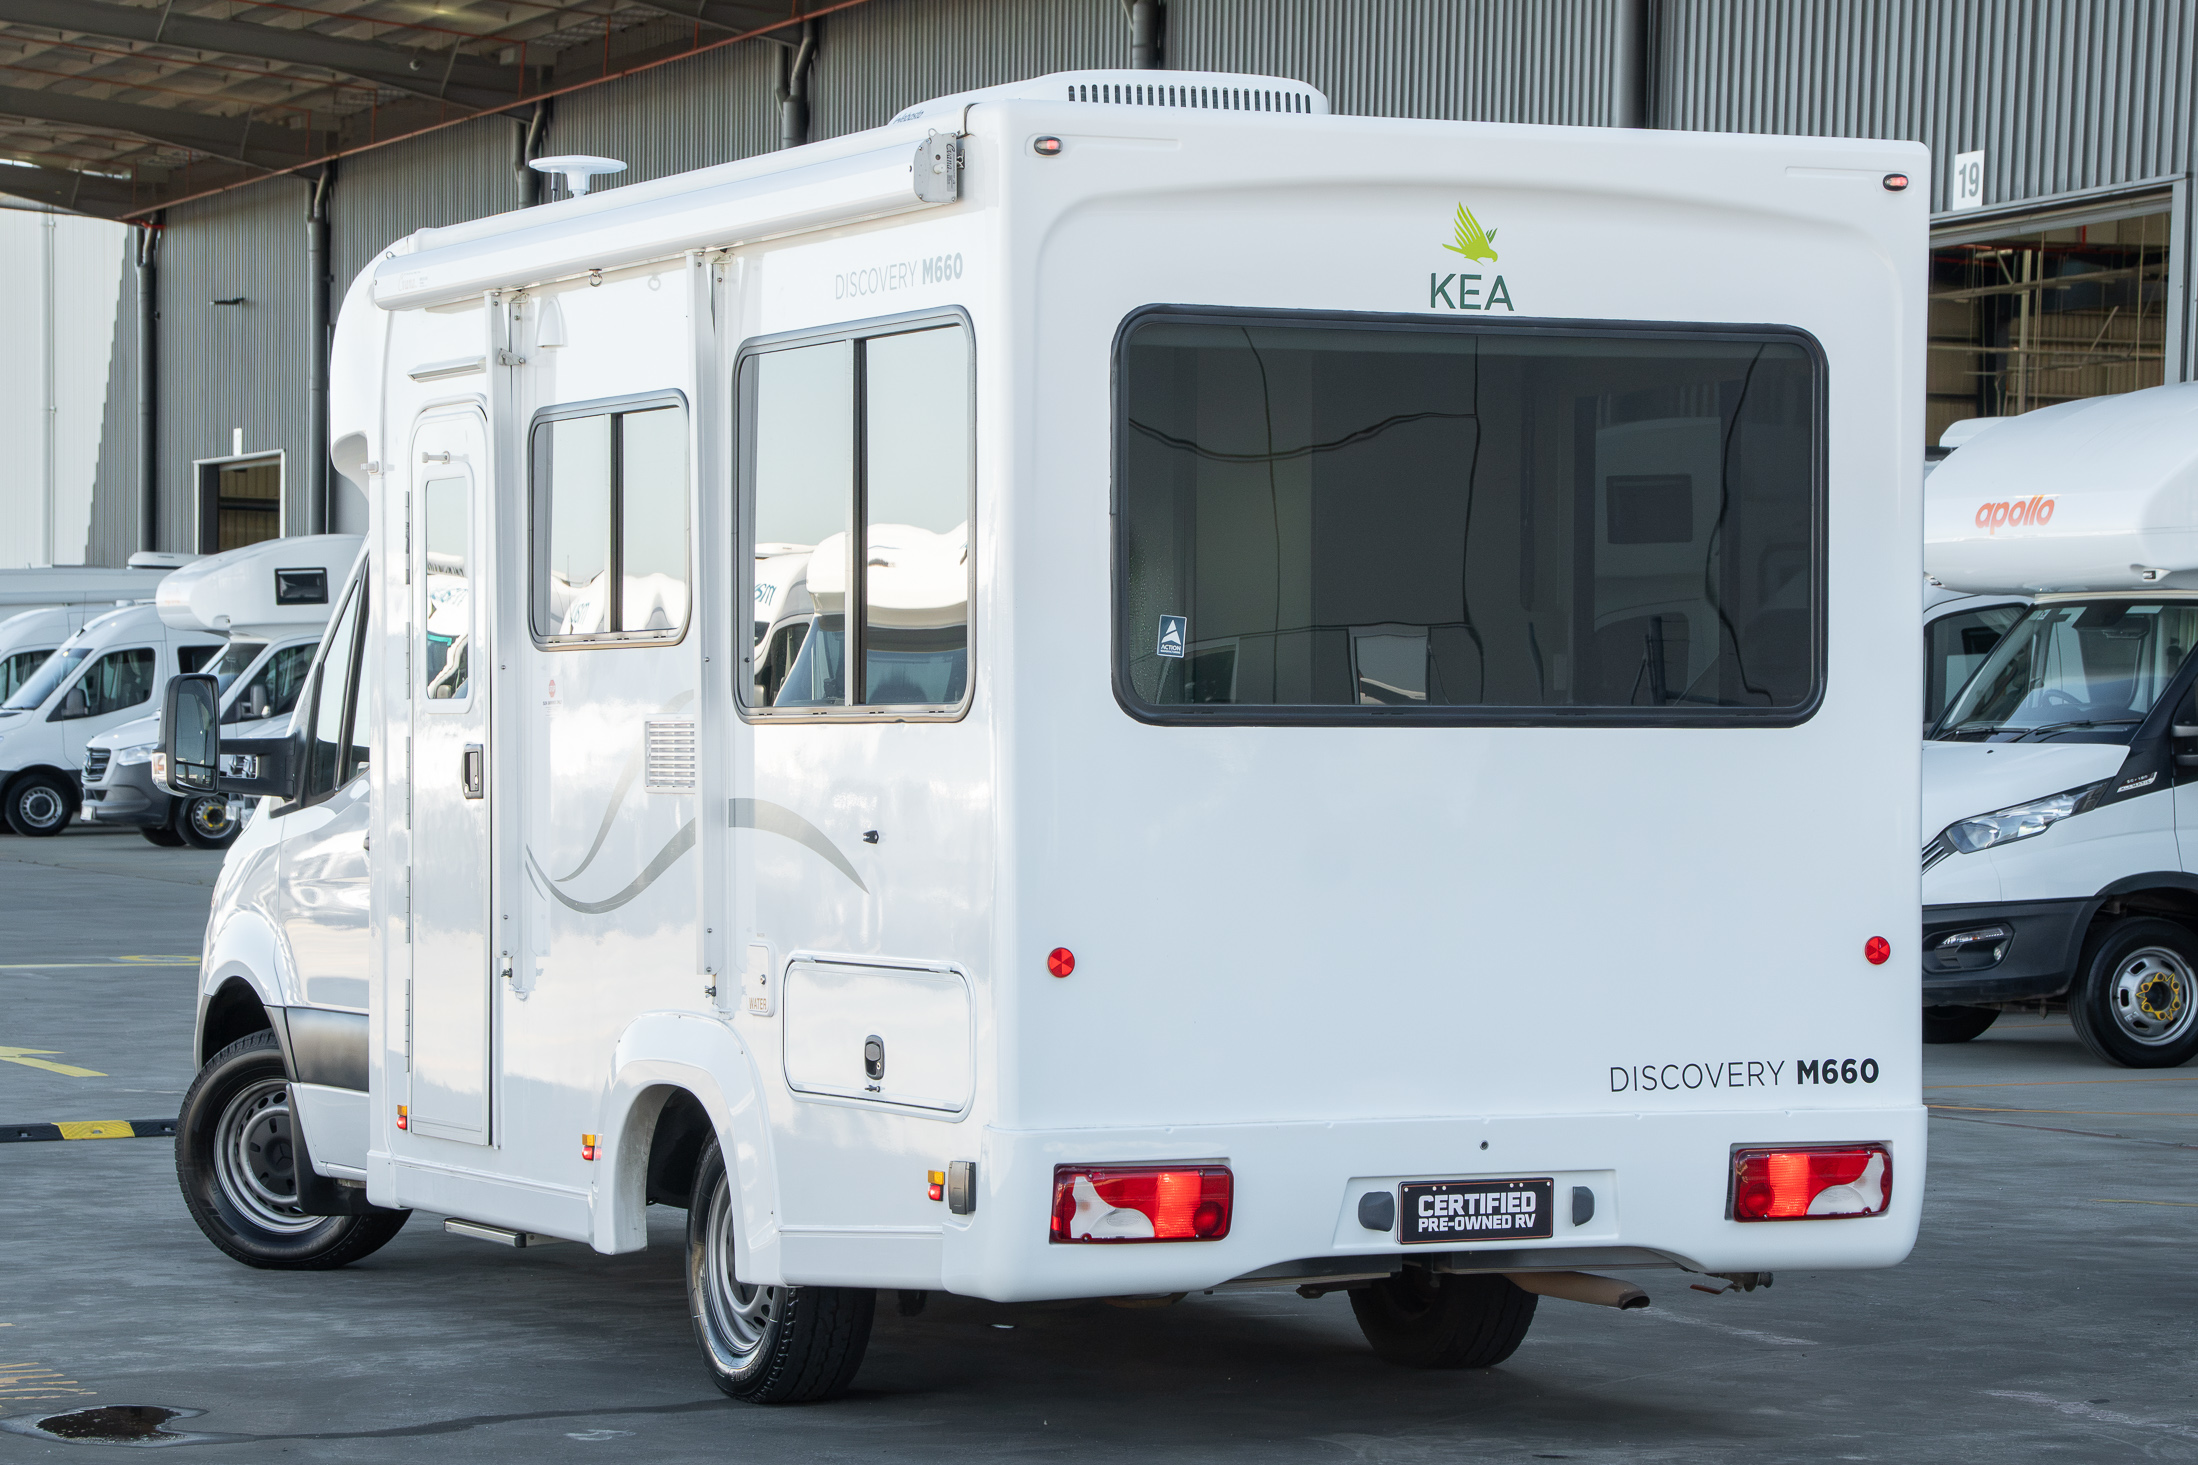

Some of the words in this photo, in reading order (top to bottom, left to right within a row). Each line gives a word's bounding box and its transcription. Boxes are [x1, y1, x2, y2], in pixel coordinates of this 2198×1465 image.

[1958, 161, 1980, 198] 19
[835, 260, 918, 300] DISCOVERY
[922, 252, 963, 285] M660
[1430, 272, 1515, 312] KEA
[1975, 494, 2055, 535] apollo
[1160, 643, 1182, 652] ACTION
[748, 997, 767, 1010] WATER
[1610, 1060, 1786, 1093] DISCOVERY
[1796, 1057, 1880, 1086] M660
[1418, 1191, 1537, 1217] CERTIFIED
[1418, 1214, 1512, 1232] PRE-OWNED
[1515, 1213, 1536, 1228] RV
